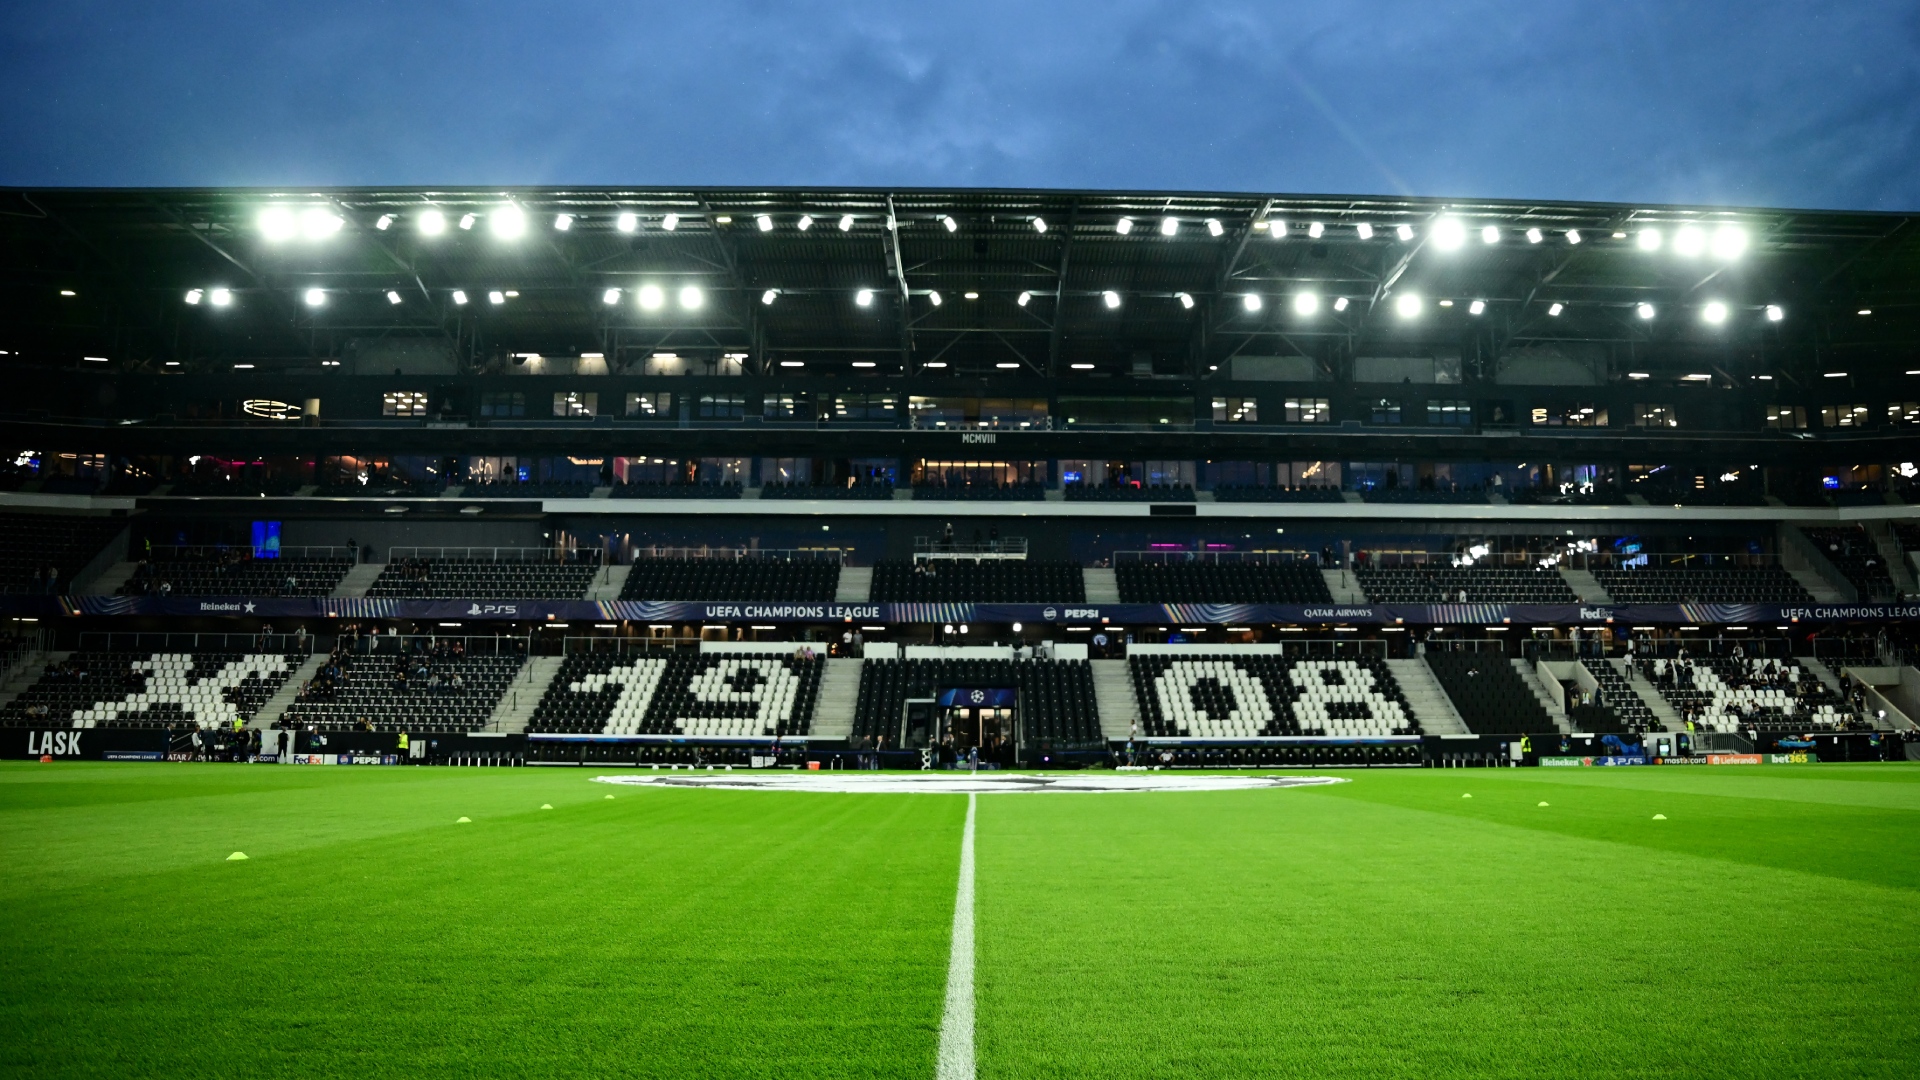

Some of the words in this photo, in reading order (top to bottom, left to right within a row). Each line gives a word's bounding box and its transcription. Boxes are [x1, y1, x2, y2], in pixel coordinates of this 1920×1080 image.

[962, 433, 996, 444] MCMVIII
[200, 602, 241, 611] Heineken
[484, 605, 517, 614] PS5
[706, 606, 742, 617] UEFA
[744, 606, 824, 618] CHAMPIONS
[828, 607, 880, 618] LEAGUE
[1064, 609, 1099, 618] PEPSI
[1303, 608, 1334, 618] QATAR
[1335, 608, 1372, 617] AIRWAYS
[1580, 607, 1613, 619] FedEx
[1780, 608, 1812, 619] UEFA
[1815, 607, 1884, 618] CHAMPIONS
[1888, 607, 1920, 617] LEAG
[28, 731, 82, 755] LASK
[294, 755, 321, 764] FedEx
[352, 756, 380, 764] PEPSI
[1541, 757, 1579, 766] Heineken
[1617, 757, 1643, 765] PS5
[1720, 756, 1758, 765] Lieferando
[1771, 754, 1808, 763] bet365
